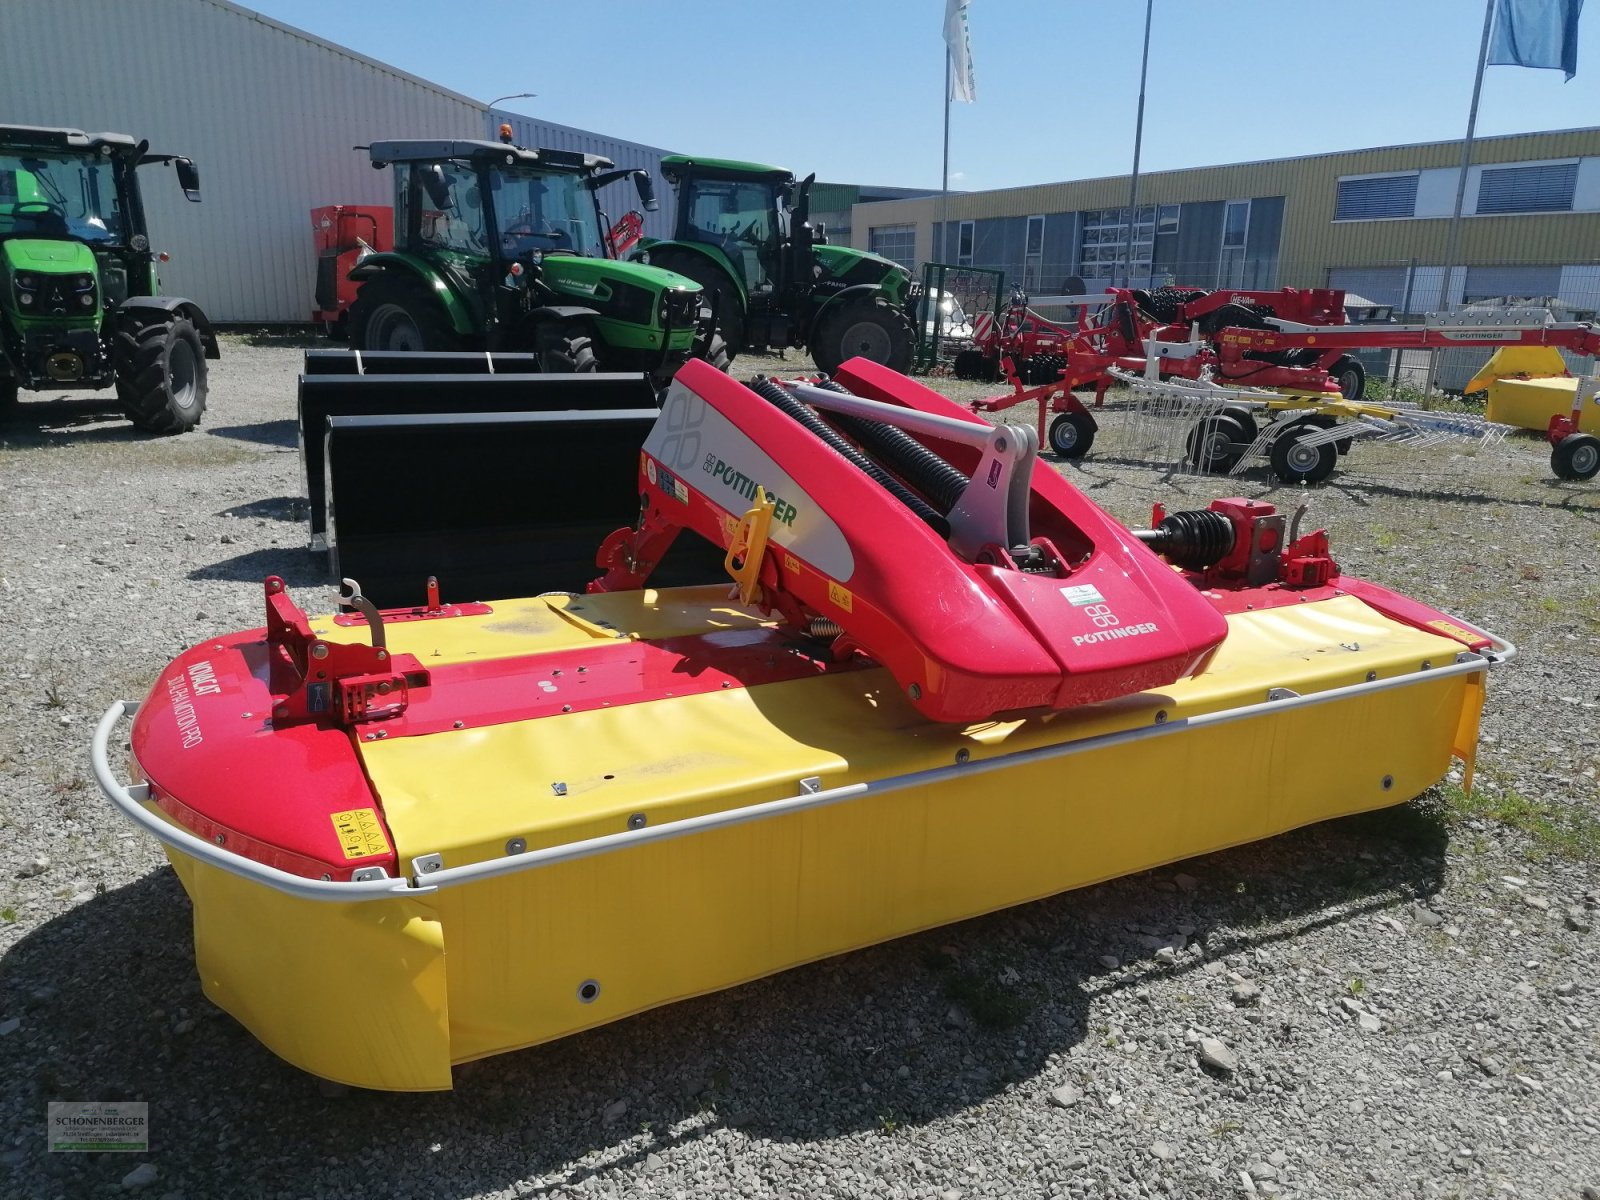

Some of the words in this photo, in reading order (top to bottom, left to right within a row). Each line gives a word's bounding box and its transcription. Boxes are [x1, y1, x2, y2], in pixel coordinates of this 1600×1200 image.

[1072, 622, 1159, 647] PÖTTINGER
[187, 661, 221, 696] NOVACAT
[173, 700, 198, 731] MOTION
[180, 727, 202, 748] PRO
